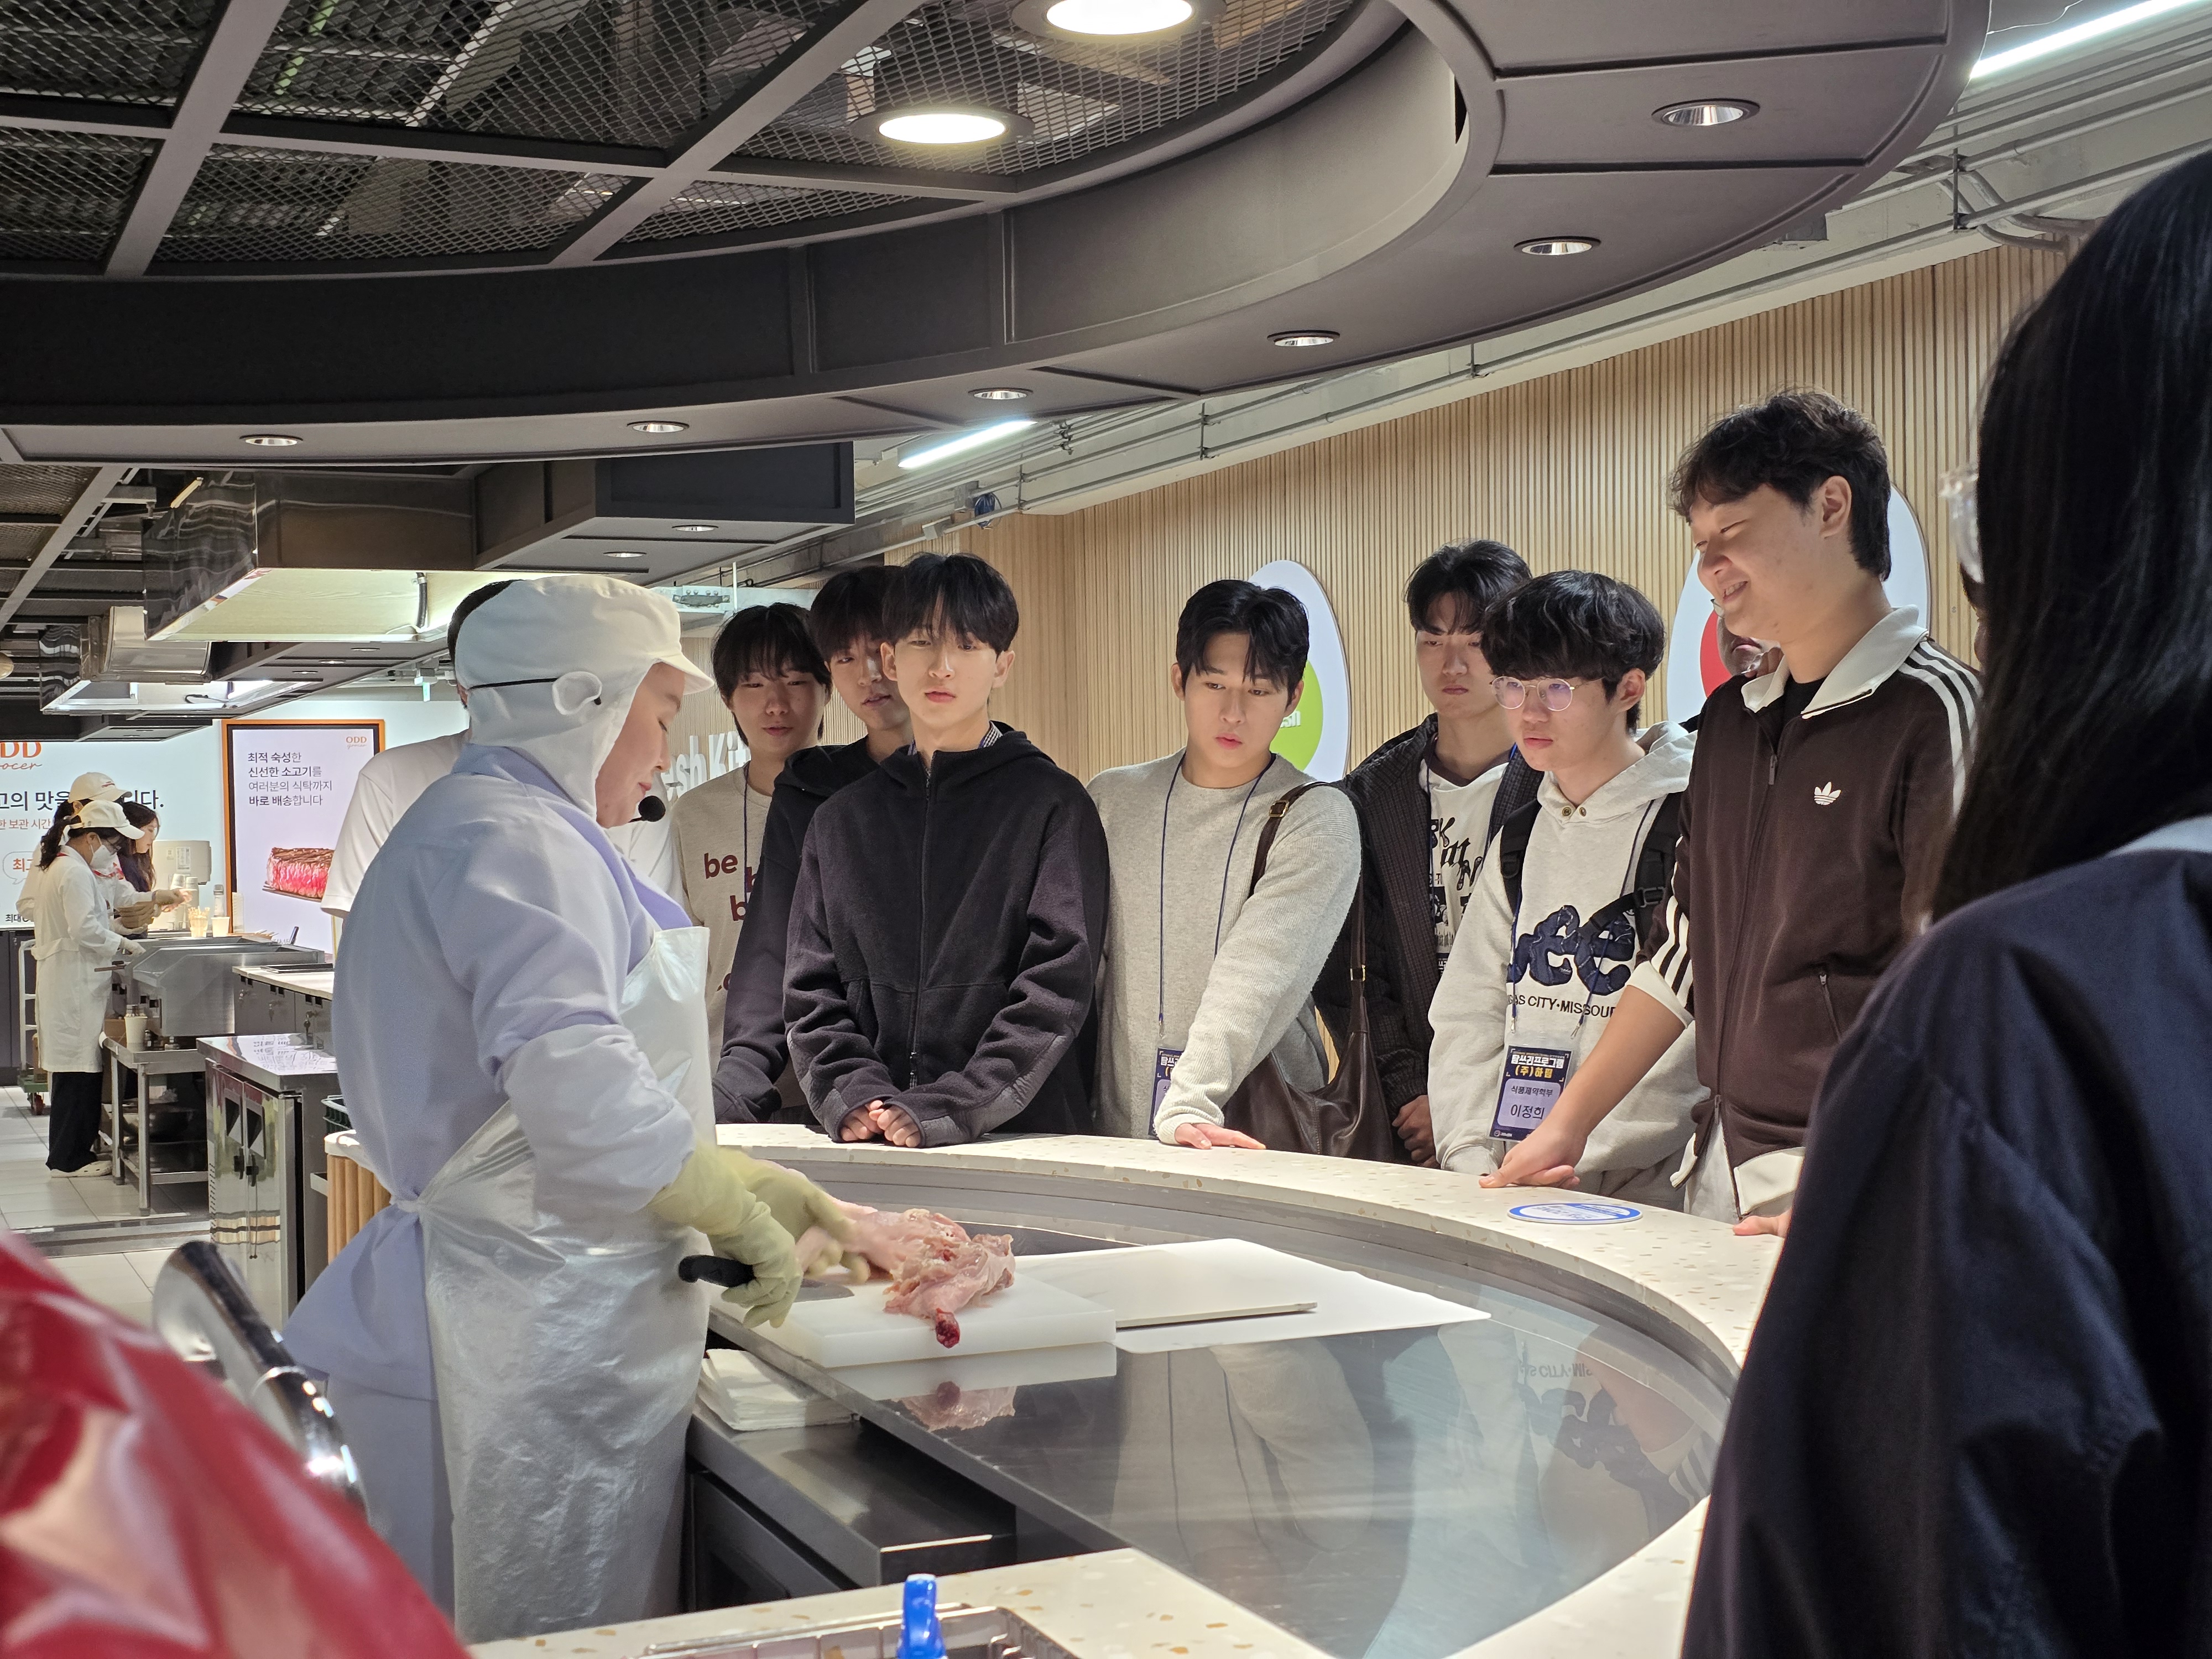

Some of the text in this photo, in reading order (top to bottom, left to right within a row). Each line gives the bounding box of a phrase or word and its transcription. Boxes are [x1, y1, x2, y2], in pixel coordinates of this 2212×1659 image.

[248, 752, 302, 763] 최적 숙성한
[248, 766, 322, 778] 신선한 소고기를
[249, 780, 332, 792] 여러분의 식탁까지
[249, 795, 323, 806] 바로 배송합니다
[9, 819, 29, 830] 보관
[31, 818, 51, 830] 시간
[704, 852, 738, 879] be
[1511, 1104, 1545, 1119] 이정희
